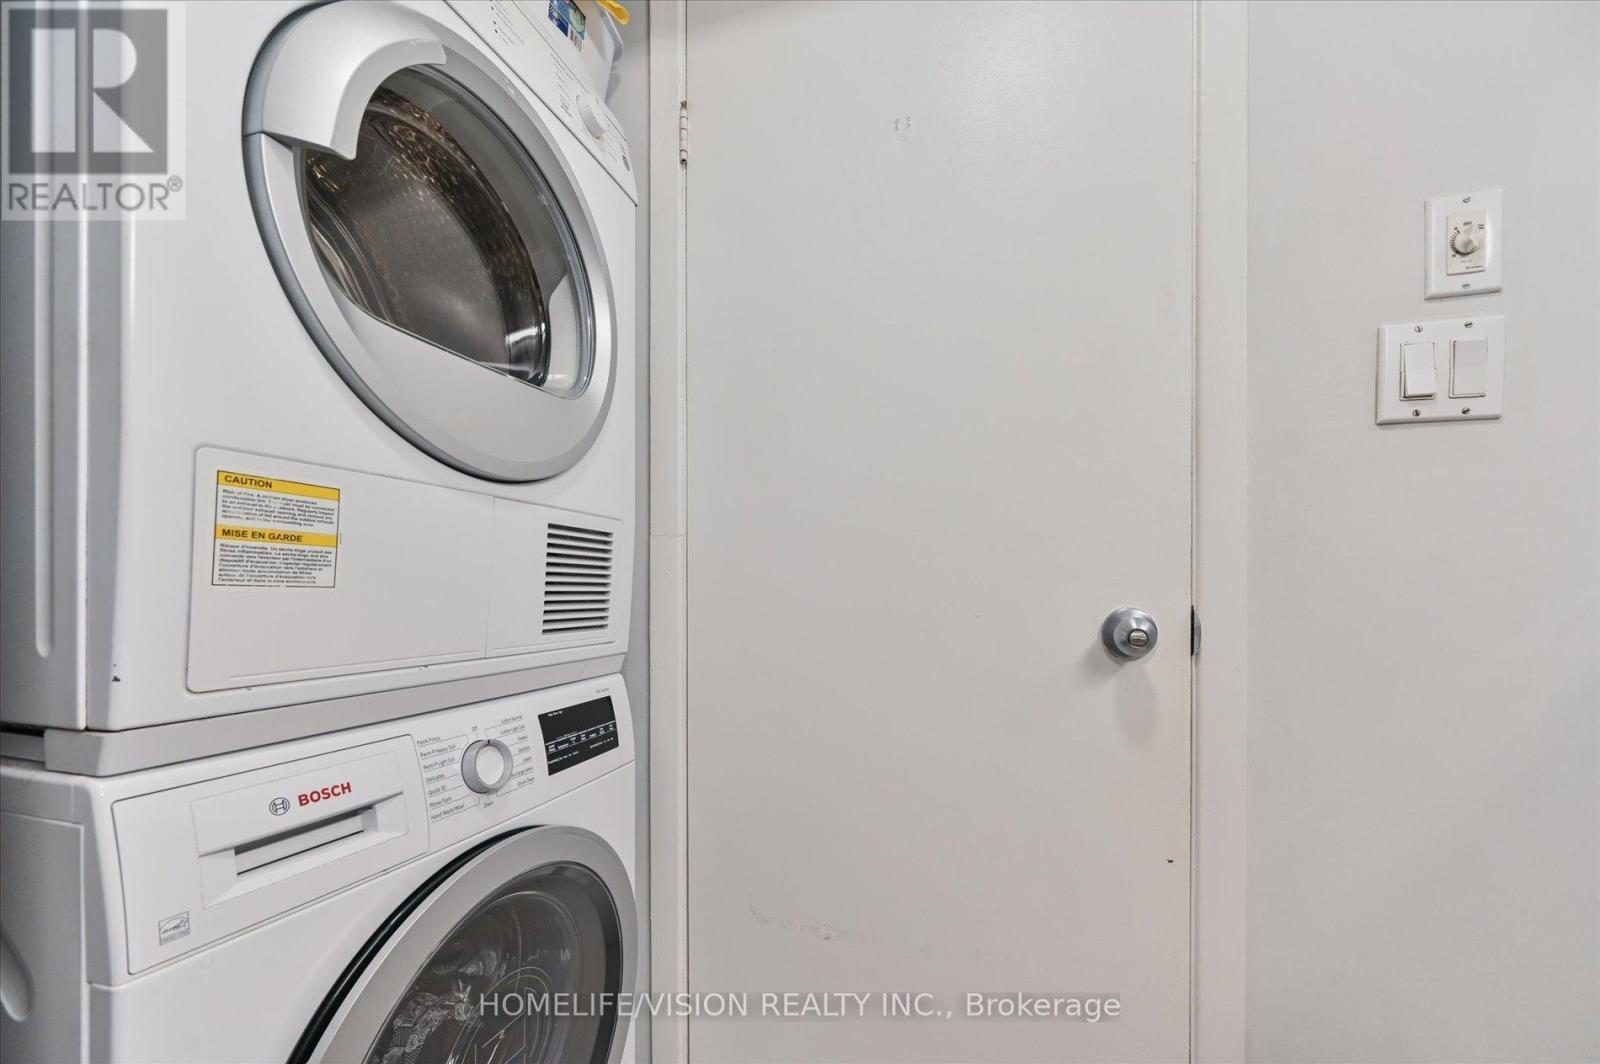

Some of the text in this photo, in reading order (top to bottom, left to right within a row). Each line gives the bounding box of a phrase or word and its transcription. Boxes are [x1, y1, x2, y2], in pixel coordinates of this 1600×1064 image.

[225, 475, 272, 489] CAUTION
[222, 529, 303, 543] MISE EN GARDE
[298, 782, 352, 806] BOSCH
